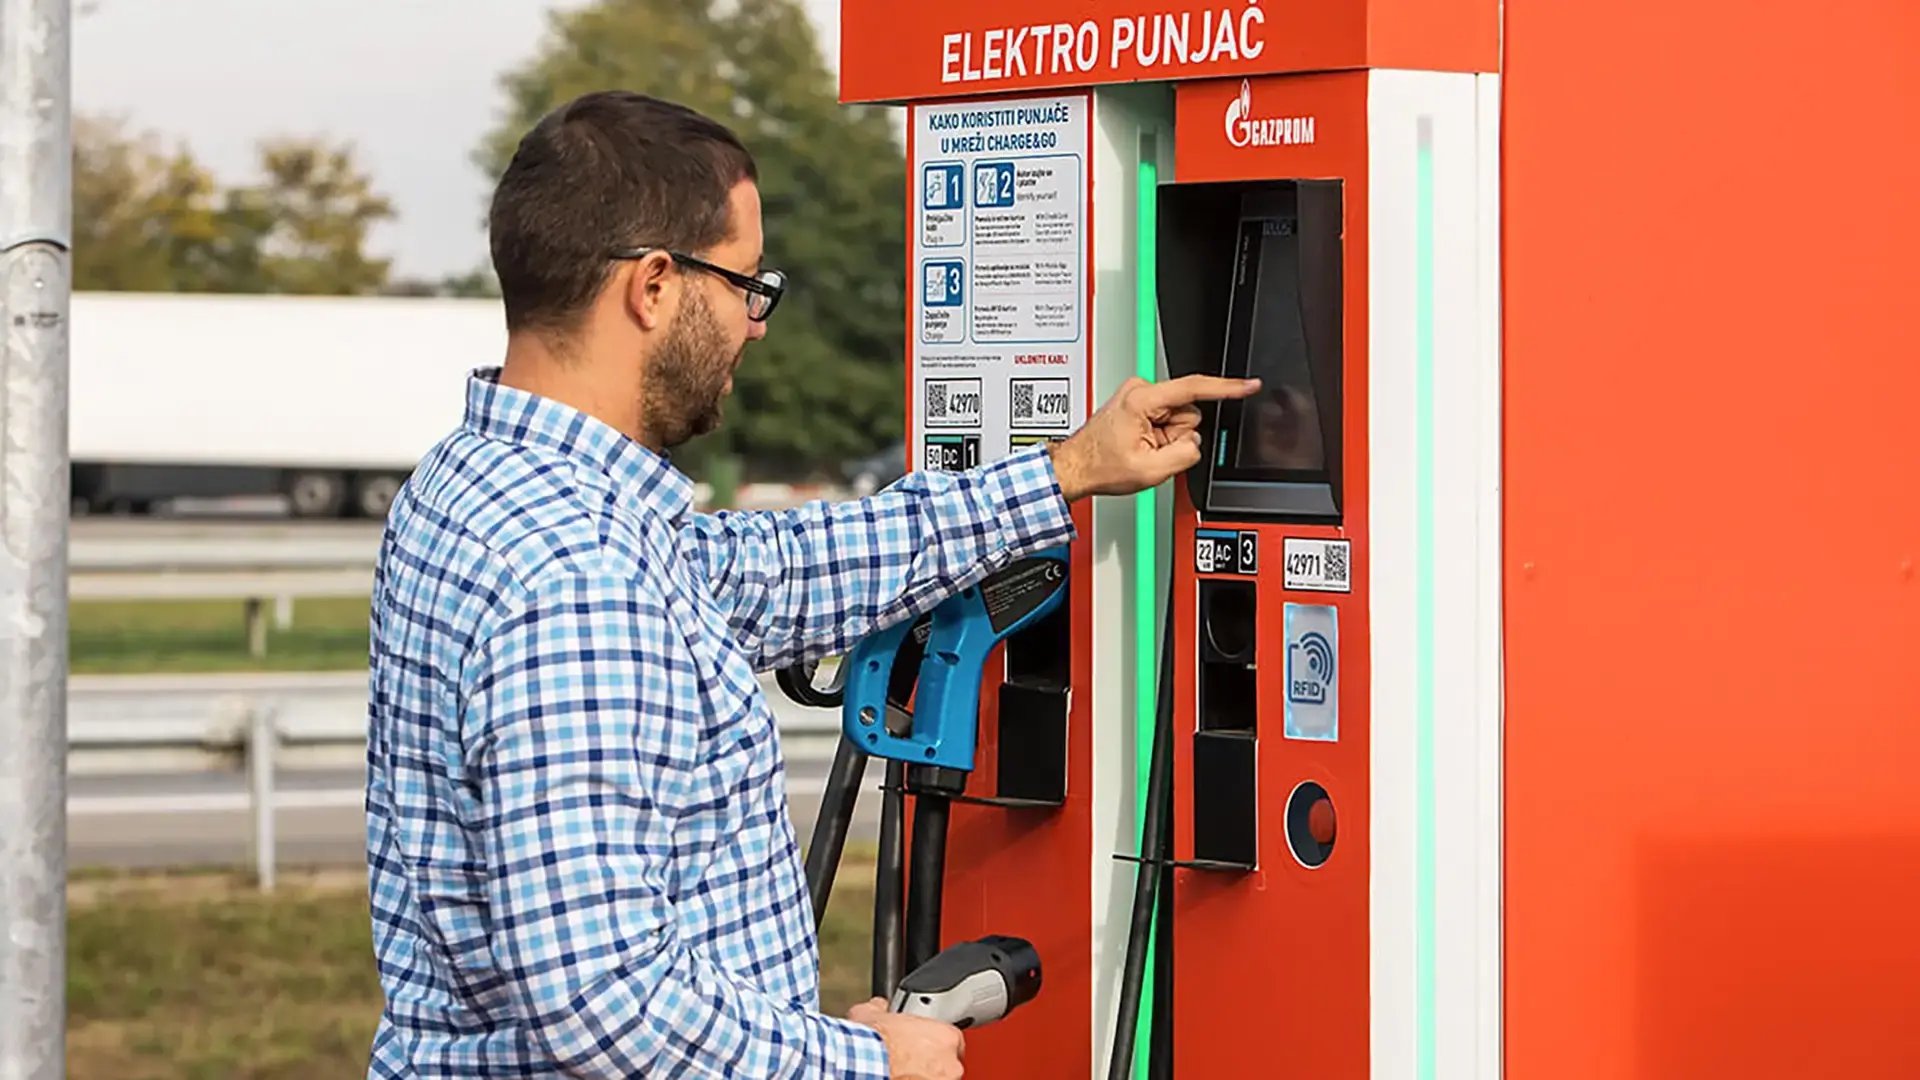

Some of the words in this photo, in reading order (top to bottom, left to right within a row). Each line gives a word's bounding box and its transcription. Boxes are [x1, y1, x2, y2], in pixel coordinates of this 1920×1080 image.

[941, 20, 1100, 83] ELEKTRO
[1110, 0, 1265, 69] PUNJAČ
[929, 114, 959, 131] KAKO
[961, 109, 1015, 128] KORISTITI
[1017, 102, 1069, 126] PUNJAČE
[941, 139, 949, 153] U
[951, 132, 985, 153] MREŽI
[987, 131, 1057, 151] CHARGE&GO
[1251, 117, 1315, 146] GAZPROM
[951, 175, 960, 202] 1
[1000, 170, 1012, 199] 2
[949, 267, 960, 295] 3
[1014, 355, 1047, 365] UKLONITE
[949, 392, 980, 414] 42970
[1036, 392, 1068, 415] 42970
[928, 449, 940, 465] 50
[944, 449, 958, 465] DC
[968, 443, 975, 466] 1
[1198, 543, 1213, 561] 22
[1214, 543, 1232, 562] AC
[1242, 538, 1254, 565] 3
[1286, 553, 1321, 577] 42971
[1293, 681, 1321, 697] RFID
